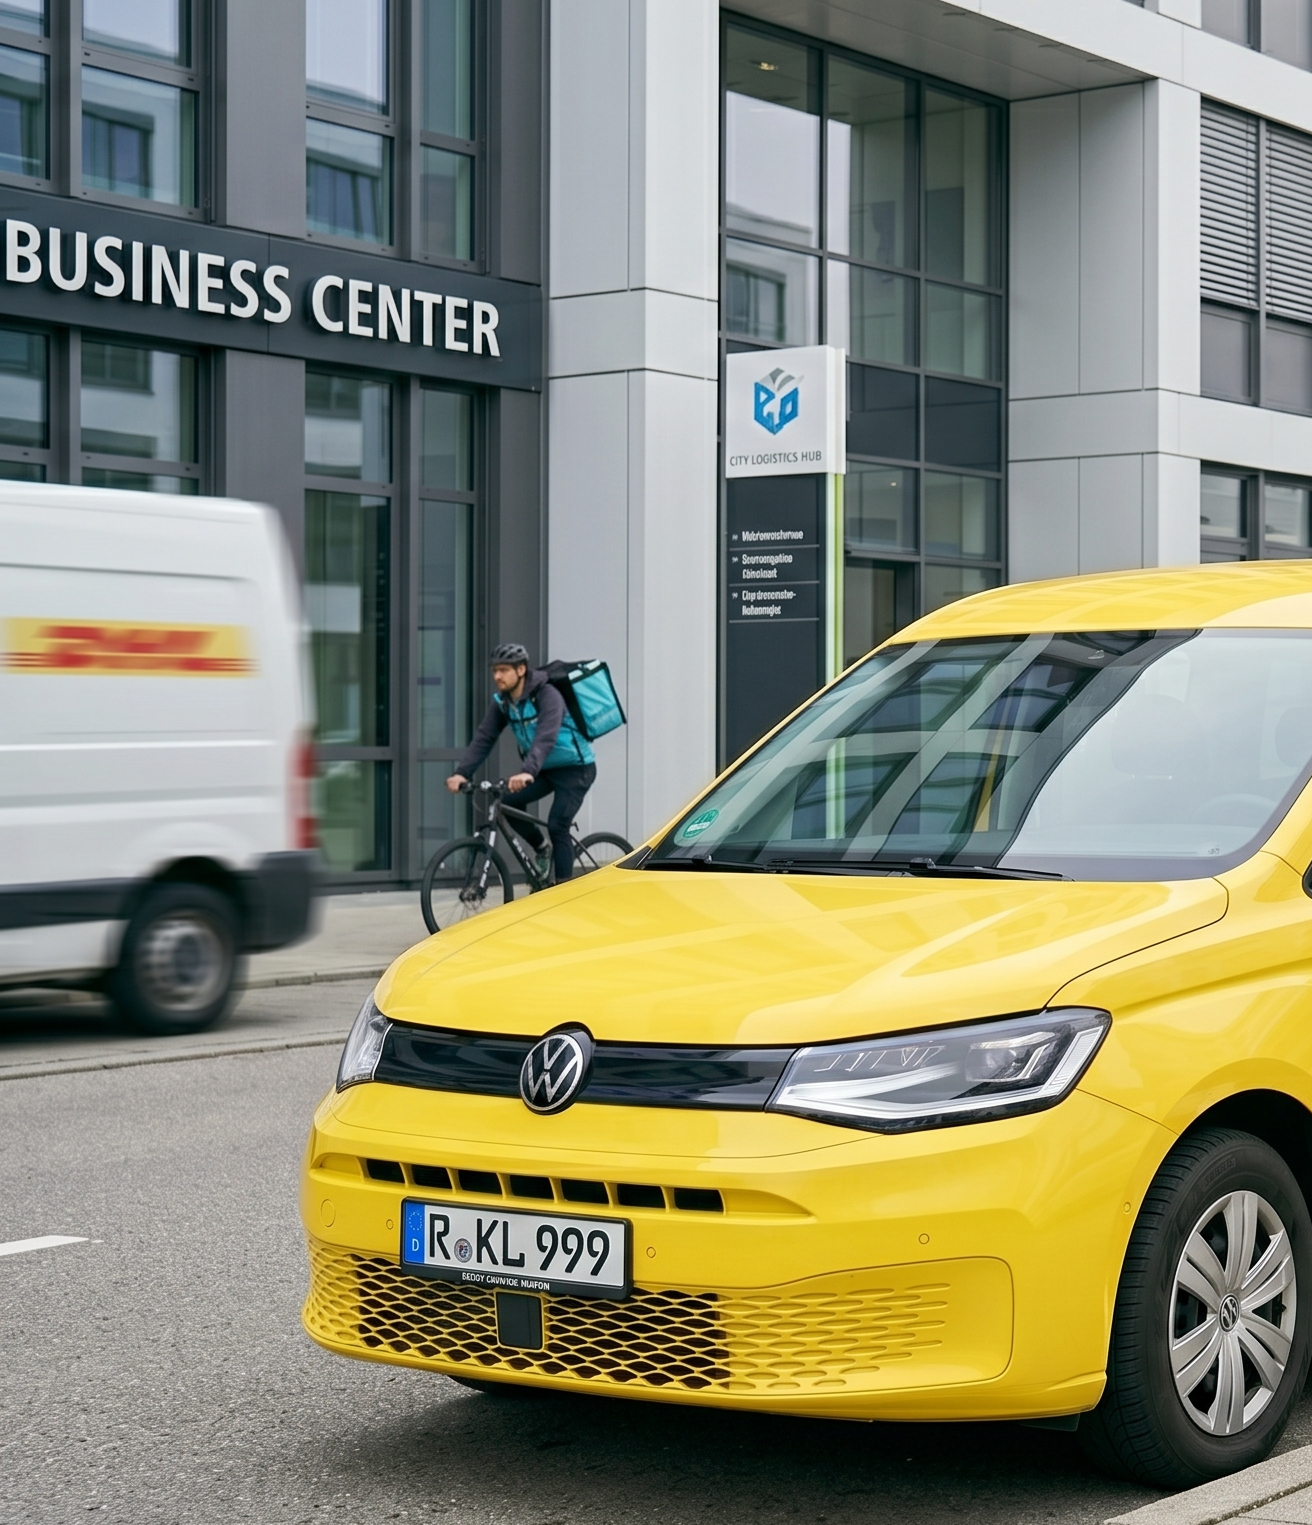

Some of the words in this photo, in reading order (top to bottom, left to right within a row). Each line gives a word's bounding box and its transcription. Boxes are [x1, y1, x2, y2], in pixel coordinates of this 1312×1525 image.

[5, 218, 292, 324] BUSINESS
[311, 274, 501, 357] CENTER
[729, 455, 749, 467] CITY
[751, 451, 798, 465] LOGISTICS
[801, 450, 822, 462] HUB
[411, 1238, 420, 1252] D
[429, 1213, 451, 1261] R
[476, 1218, 526, 1268] KL
[536, 1224, 611, 1277] 999
